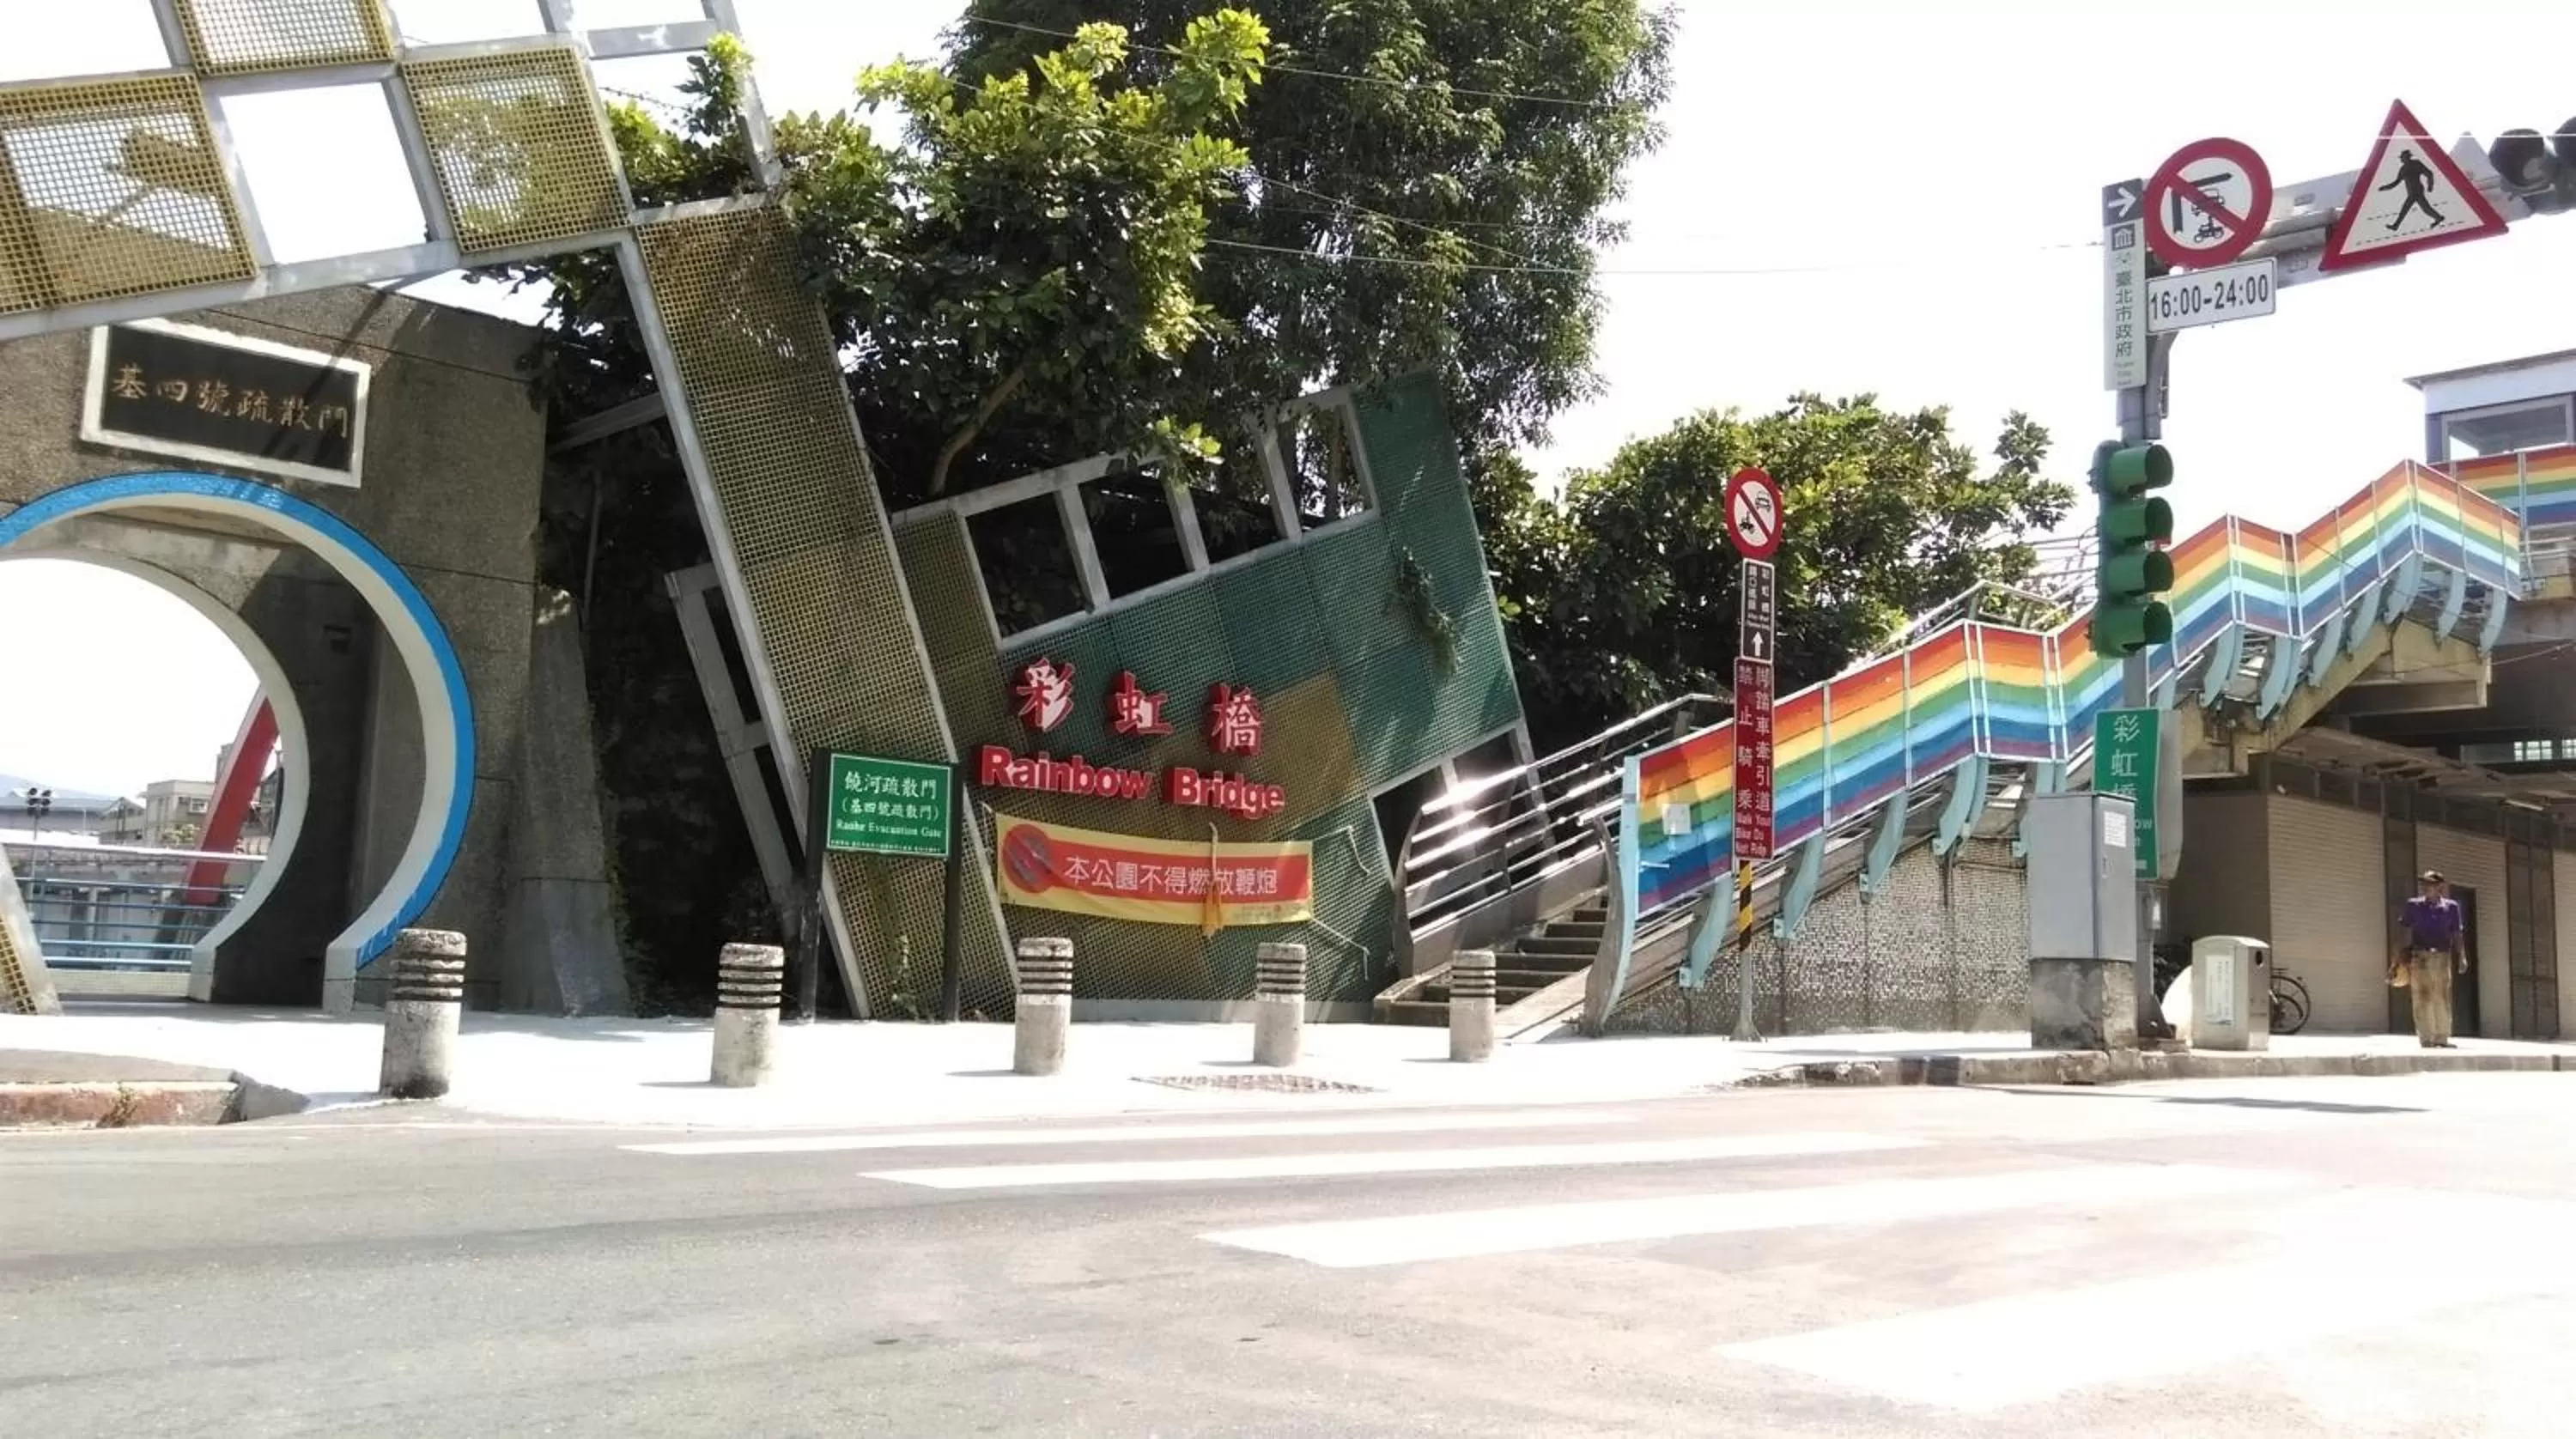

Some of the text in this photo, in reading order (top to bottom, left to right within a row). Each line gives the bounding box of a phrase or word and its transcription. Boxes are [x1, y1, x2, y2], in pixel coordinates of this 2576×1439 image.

[2150, 274, 2269, 320] 16:00-24:00
[112, 361, 348, 438] 基四號疏散門
[1016, 657, 1265, 756] 彩虹橋
[1737, 665, 1753, 810] 禁止騎乘
[981, 744, 1286, 820] Rainbow Bridge
[1064, 856, 1279, 896] 本公園不得燃放鞭炮
